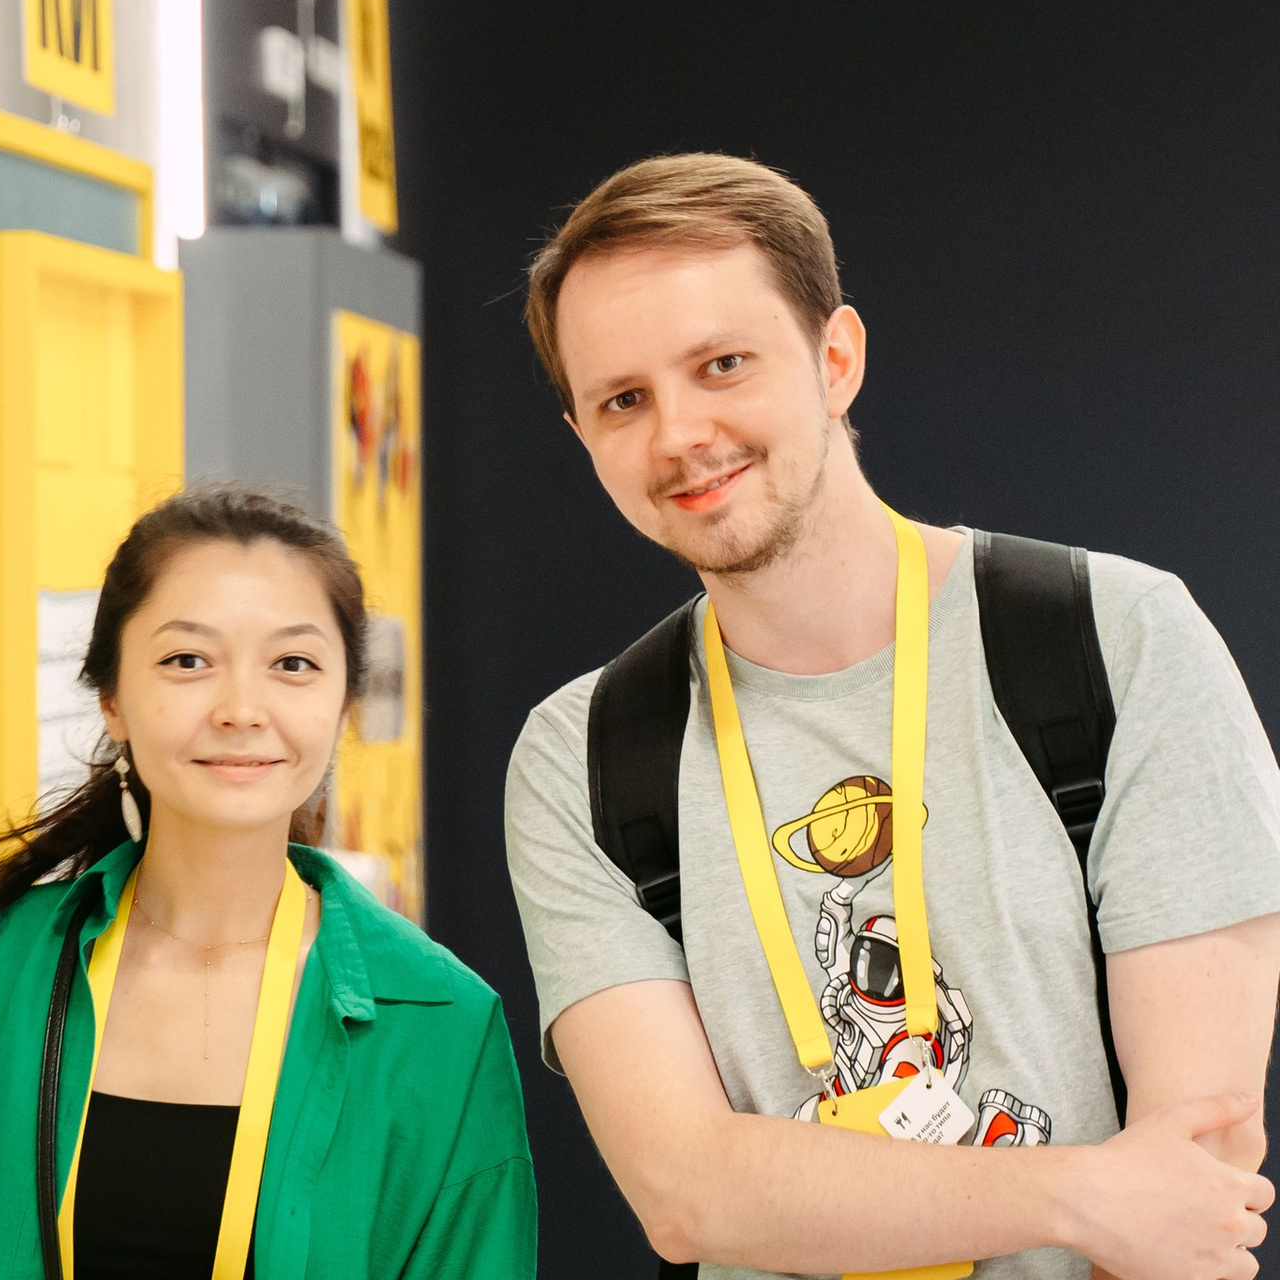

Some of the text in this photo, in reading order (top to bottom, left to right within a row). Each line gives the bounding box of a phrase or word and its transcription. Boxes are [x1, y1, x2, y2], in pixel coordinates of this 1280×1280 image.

[921, 1121, 933, 1134] нас
[931, 1101, 951, 1121] будет
[922, 1113, 952, 1144] о-то типа
